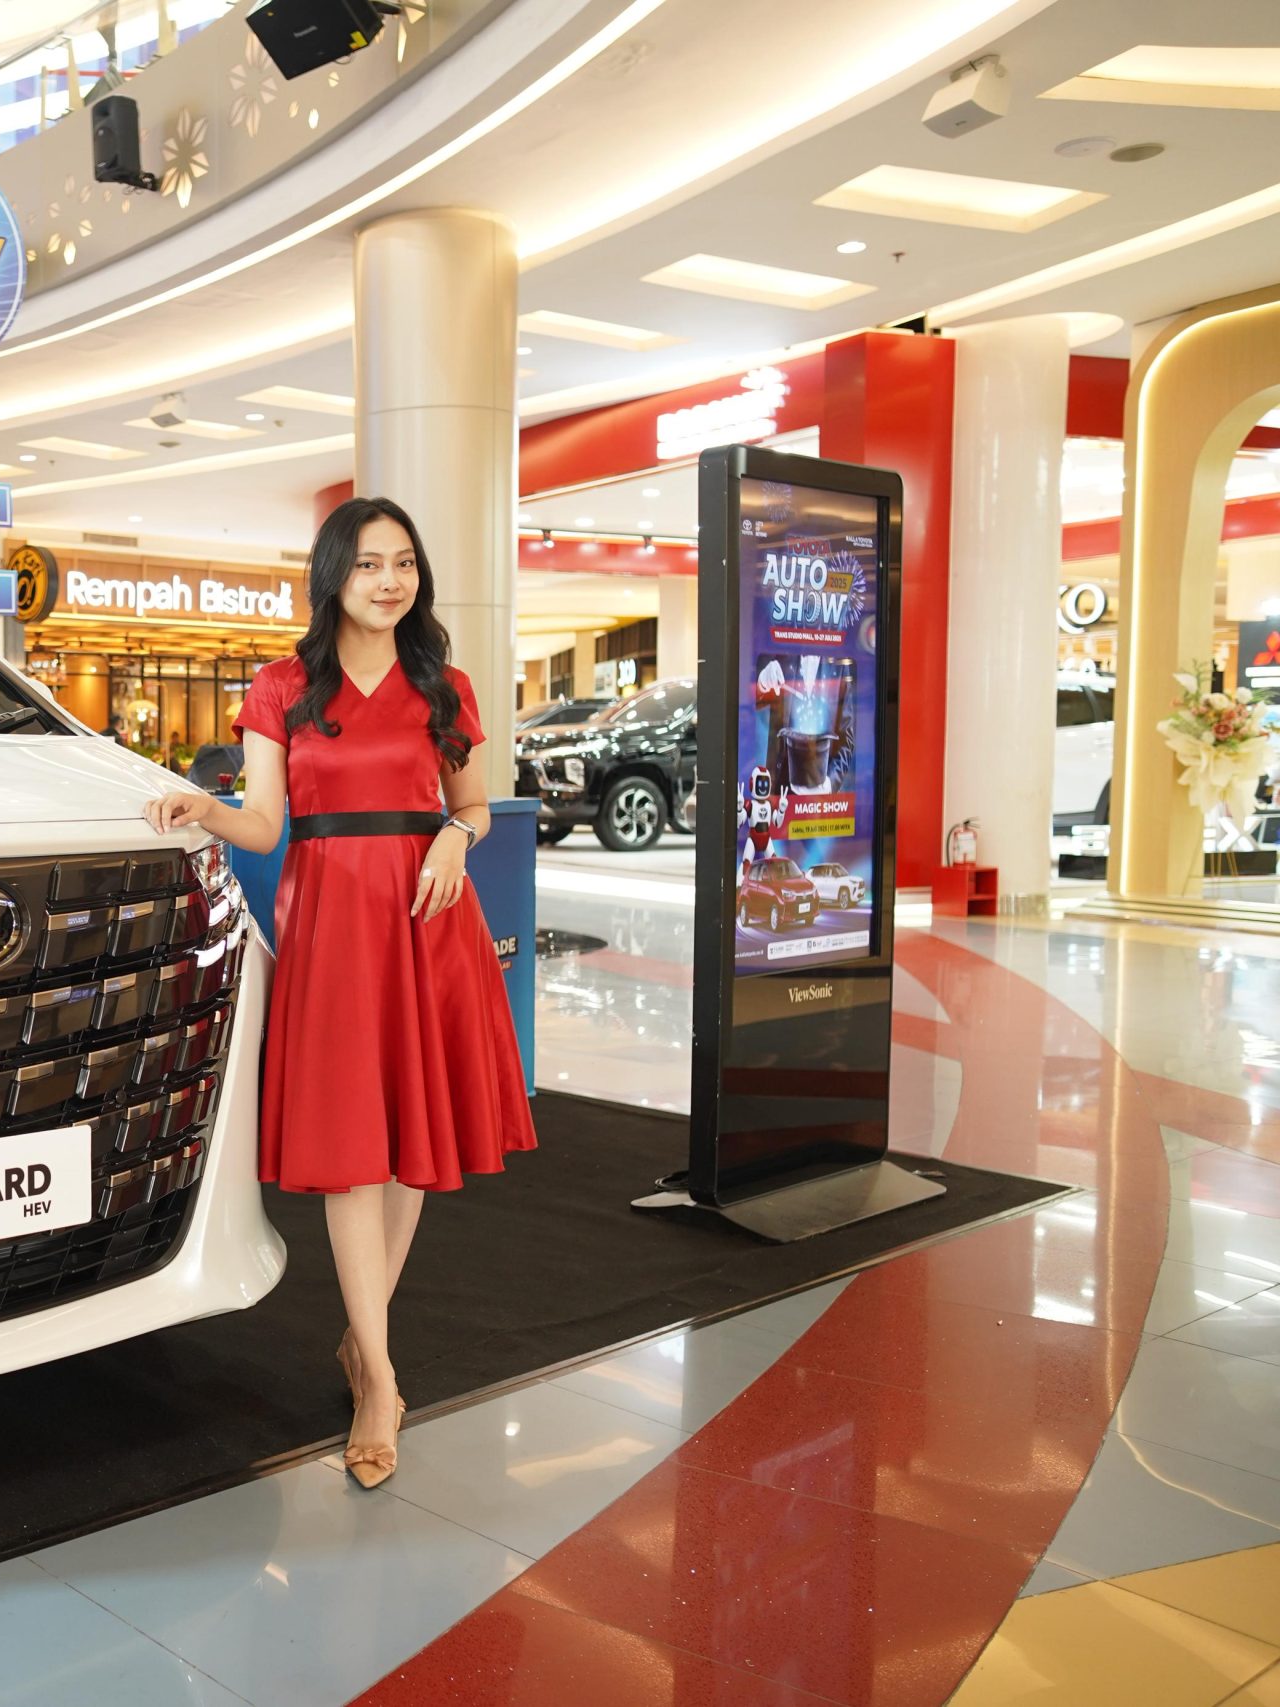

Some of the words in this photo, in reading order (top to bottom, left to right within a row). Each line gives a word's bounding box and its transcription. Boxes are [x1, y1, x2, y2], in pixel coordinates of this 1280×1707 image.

[787, 538, 830, 555] TOYOTA
[763, 554, 828, 590] AUTO
[830, 577, 847, 588] 2025
[66, 570, 192, 616] Rempah
[199, 579, 280, 617] Bistro
[773, 588, 848, 624] SHOW
[794, 803, 822, 814] MAGIC
[823, 801, 848, 813] SHOW
[788, 983, 833, 1003] ViewSonic
[23, 1200, 52, 1218] HEV
